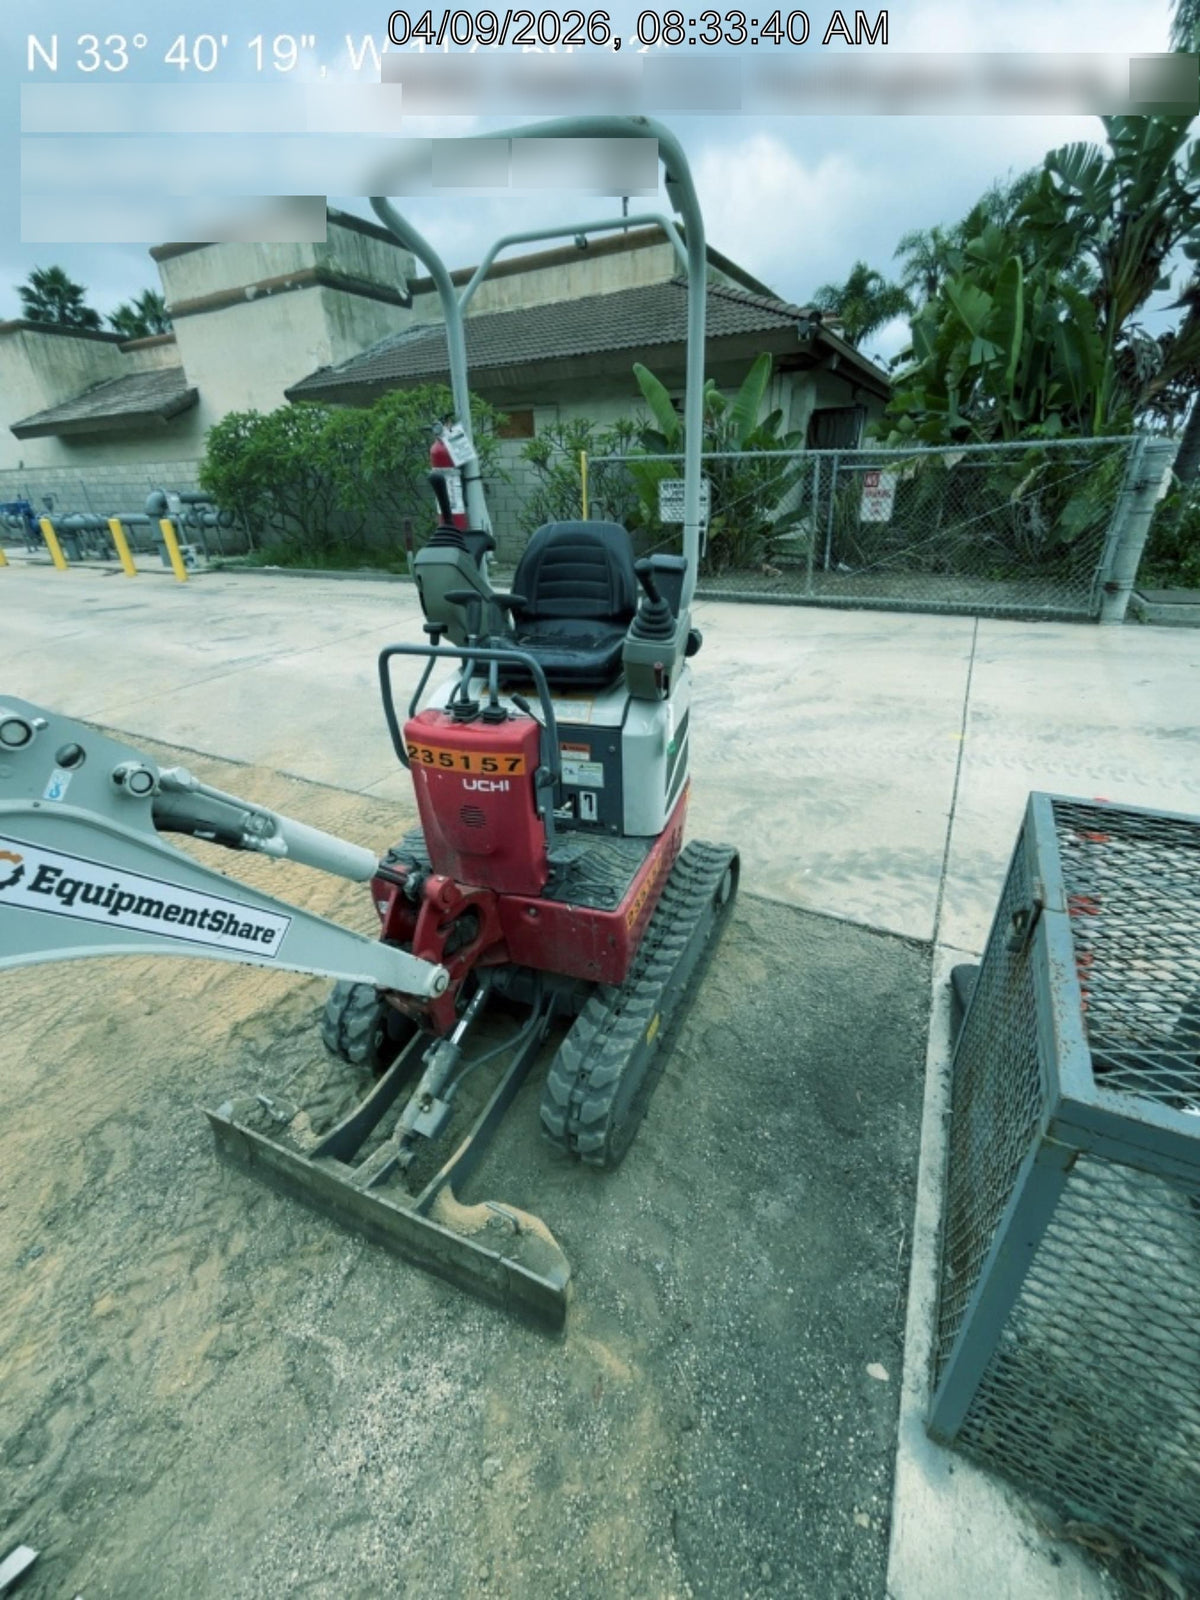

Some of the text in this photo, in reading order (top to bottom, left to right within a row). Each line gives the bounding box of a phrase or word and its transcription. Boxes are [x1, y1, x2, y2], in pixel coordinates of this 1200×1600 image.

[406, 744, 523, 773] 235157
[462, 778, 510, 793] UCHI
[26, 863, 277, 945] EquipmentShare
